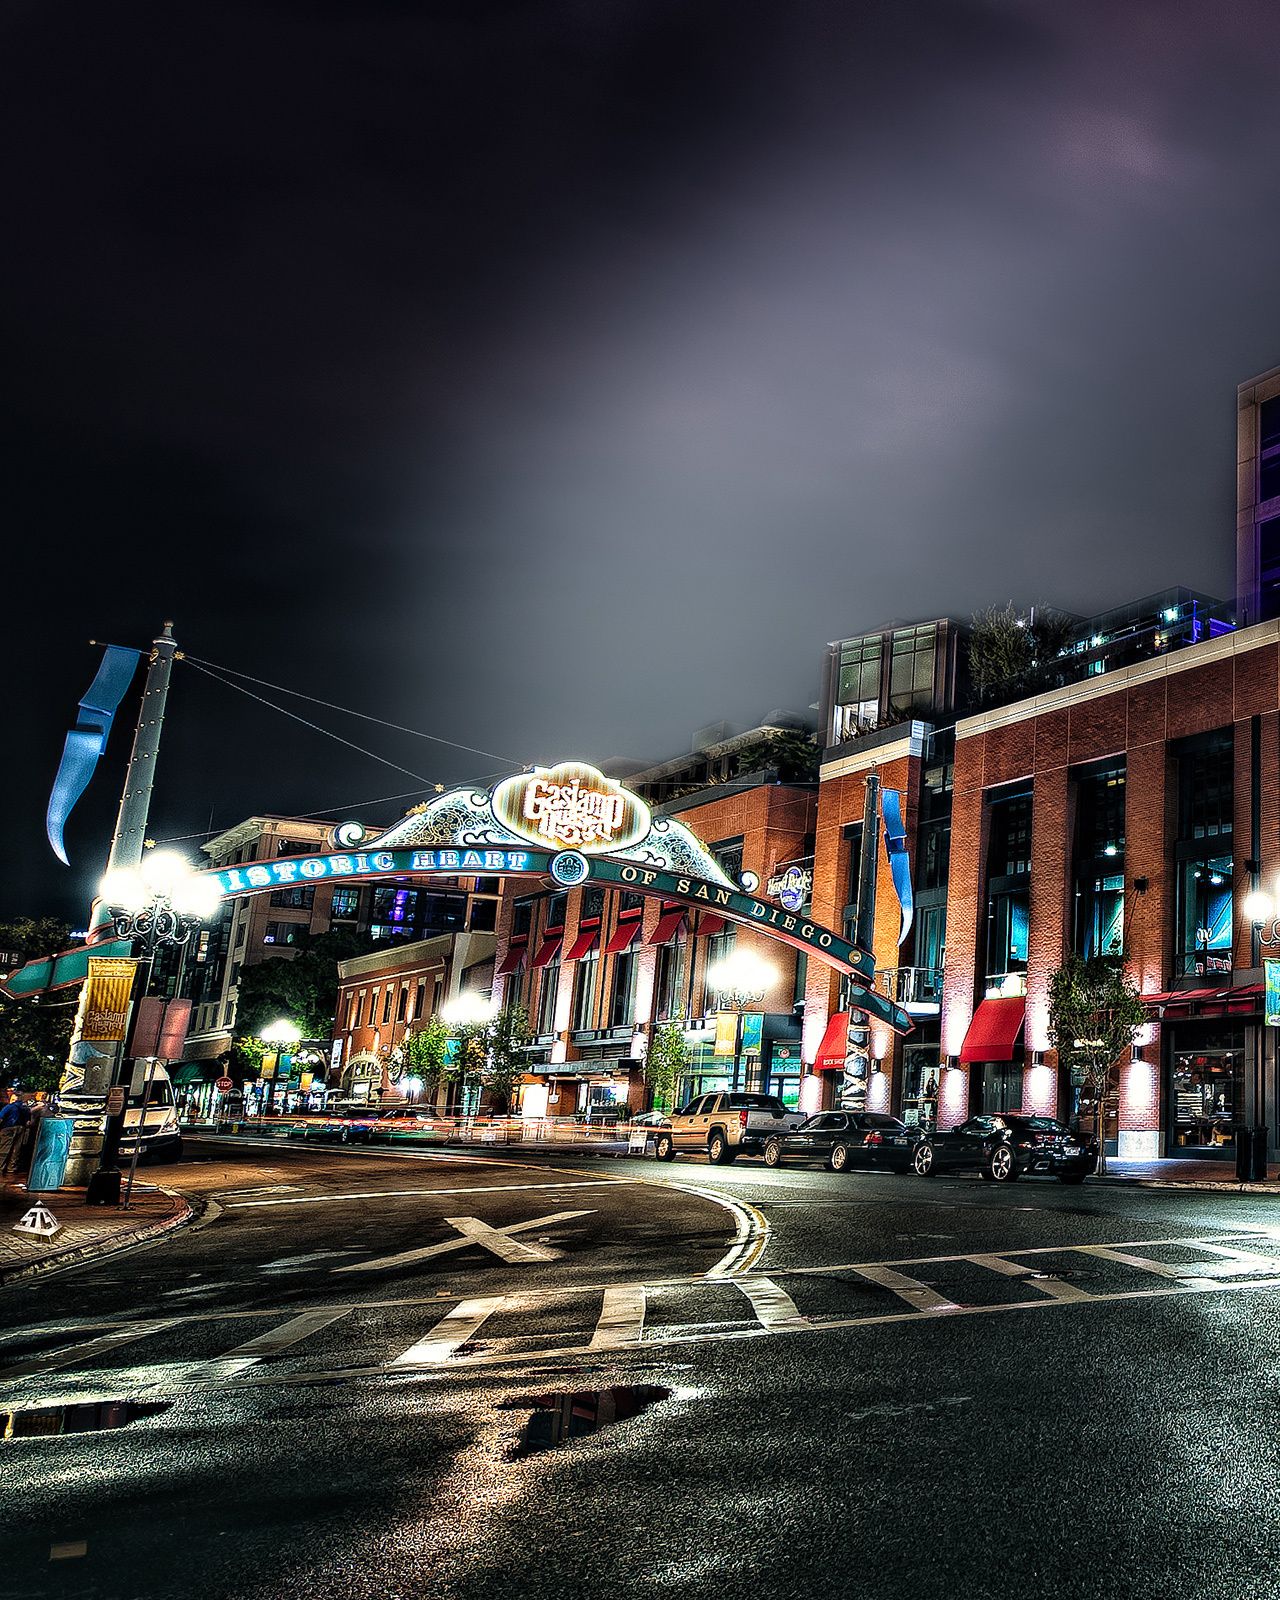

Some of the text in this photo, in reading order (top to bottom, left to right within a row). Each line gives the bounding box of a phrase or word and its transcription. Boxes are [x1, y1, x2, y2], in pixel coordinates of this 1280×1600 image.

[524, 778, 626, 832] Gaslamp
[212, 850, 833, 948] ISTORIC HEART OF SAN DIEGO
[767, 874, 788, 895] Hard
[86, 1008, 127, 1030] Gaslamp
